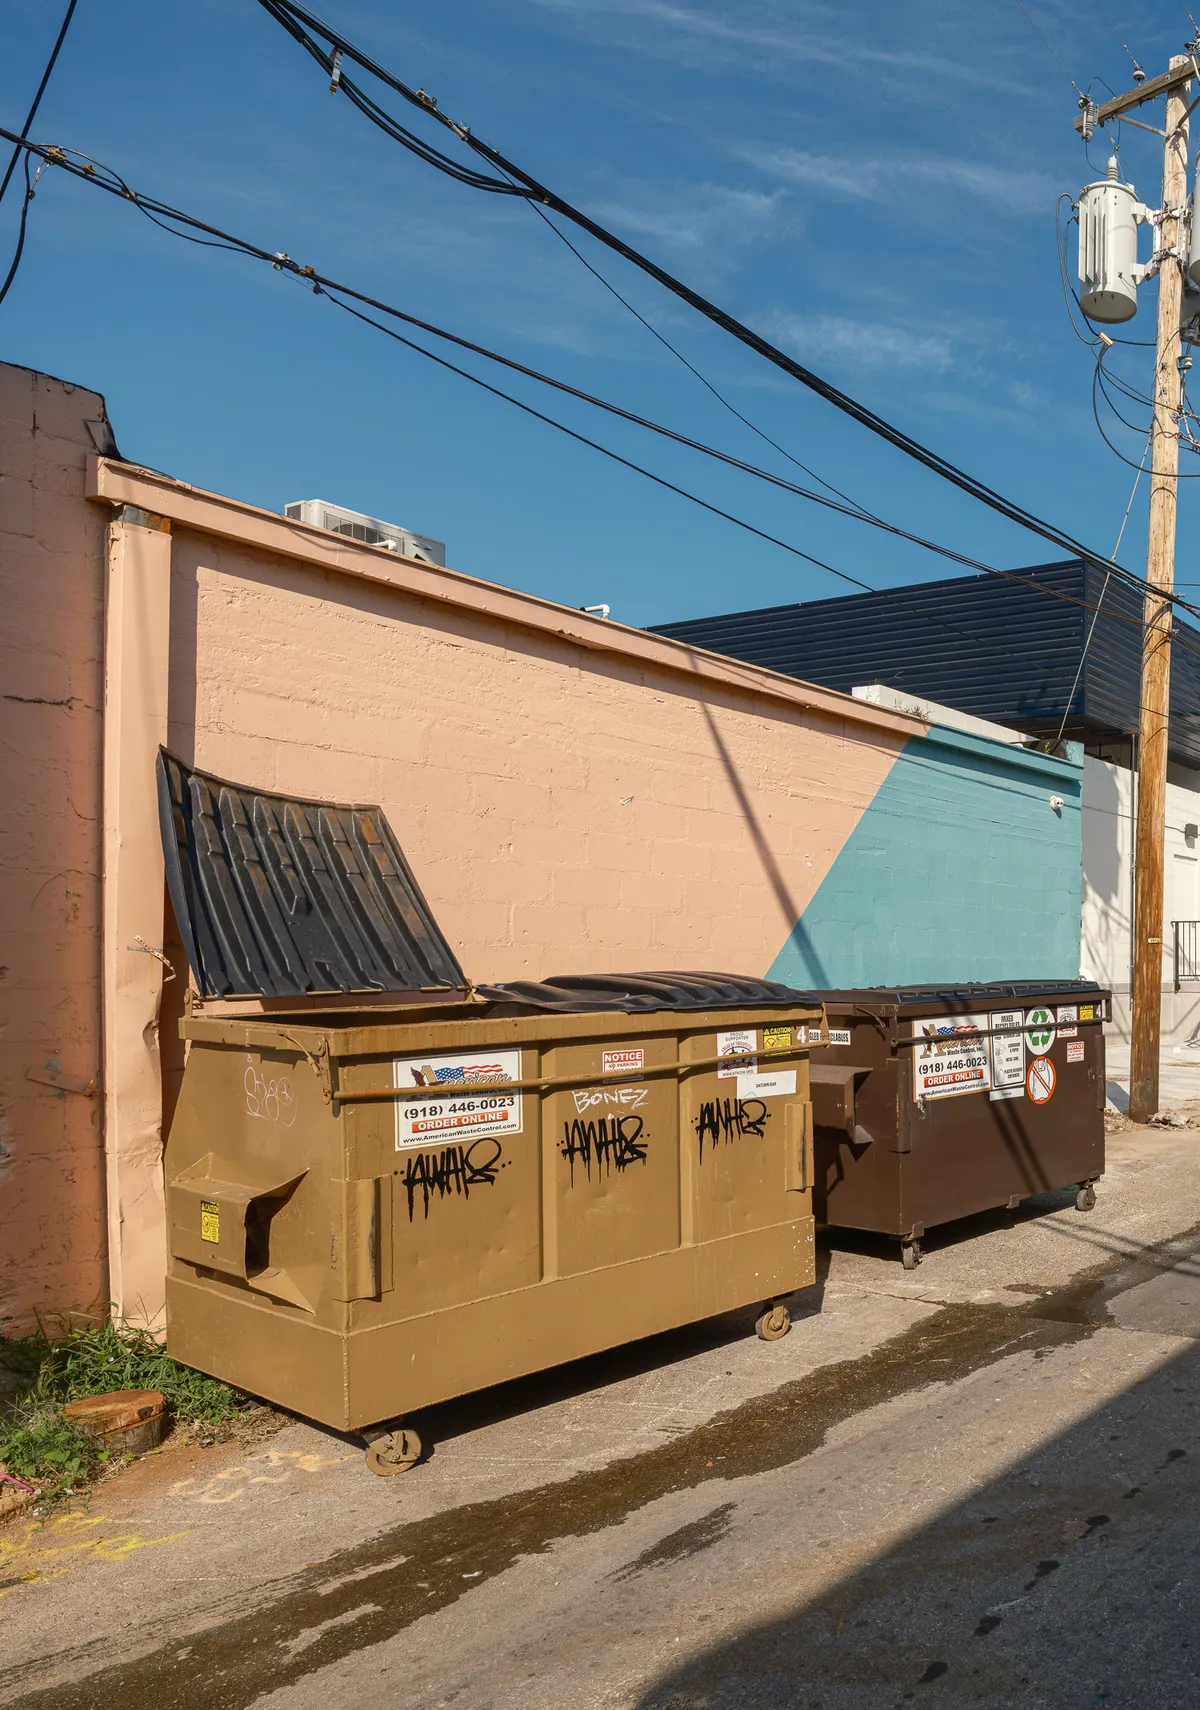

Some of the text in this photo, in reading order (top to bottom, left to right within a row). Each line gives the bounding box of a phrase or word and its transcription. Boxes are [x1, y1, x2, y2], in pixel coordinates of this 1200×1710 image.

[796, 1025, 807, 1044] 4
[604, 1052, 642, 1062] NOTICE
[918, 1056, 988, 1075] (918) 446-0023
[927, 1071, 981, 1085] ORDER ONLINE
[917, 1081, 990, 1098] www.AmericanWasteControl.com
[404, 1097, 515, 1120] (918) 446-0023
[572, 1089, 648, 1114] BONEZ
[417, 1111, 503, 1131] ORDER ONLINE
[402, 1122, 517, 1144] www.AmericanWasteControl.com
